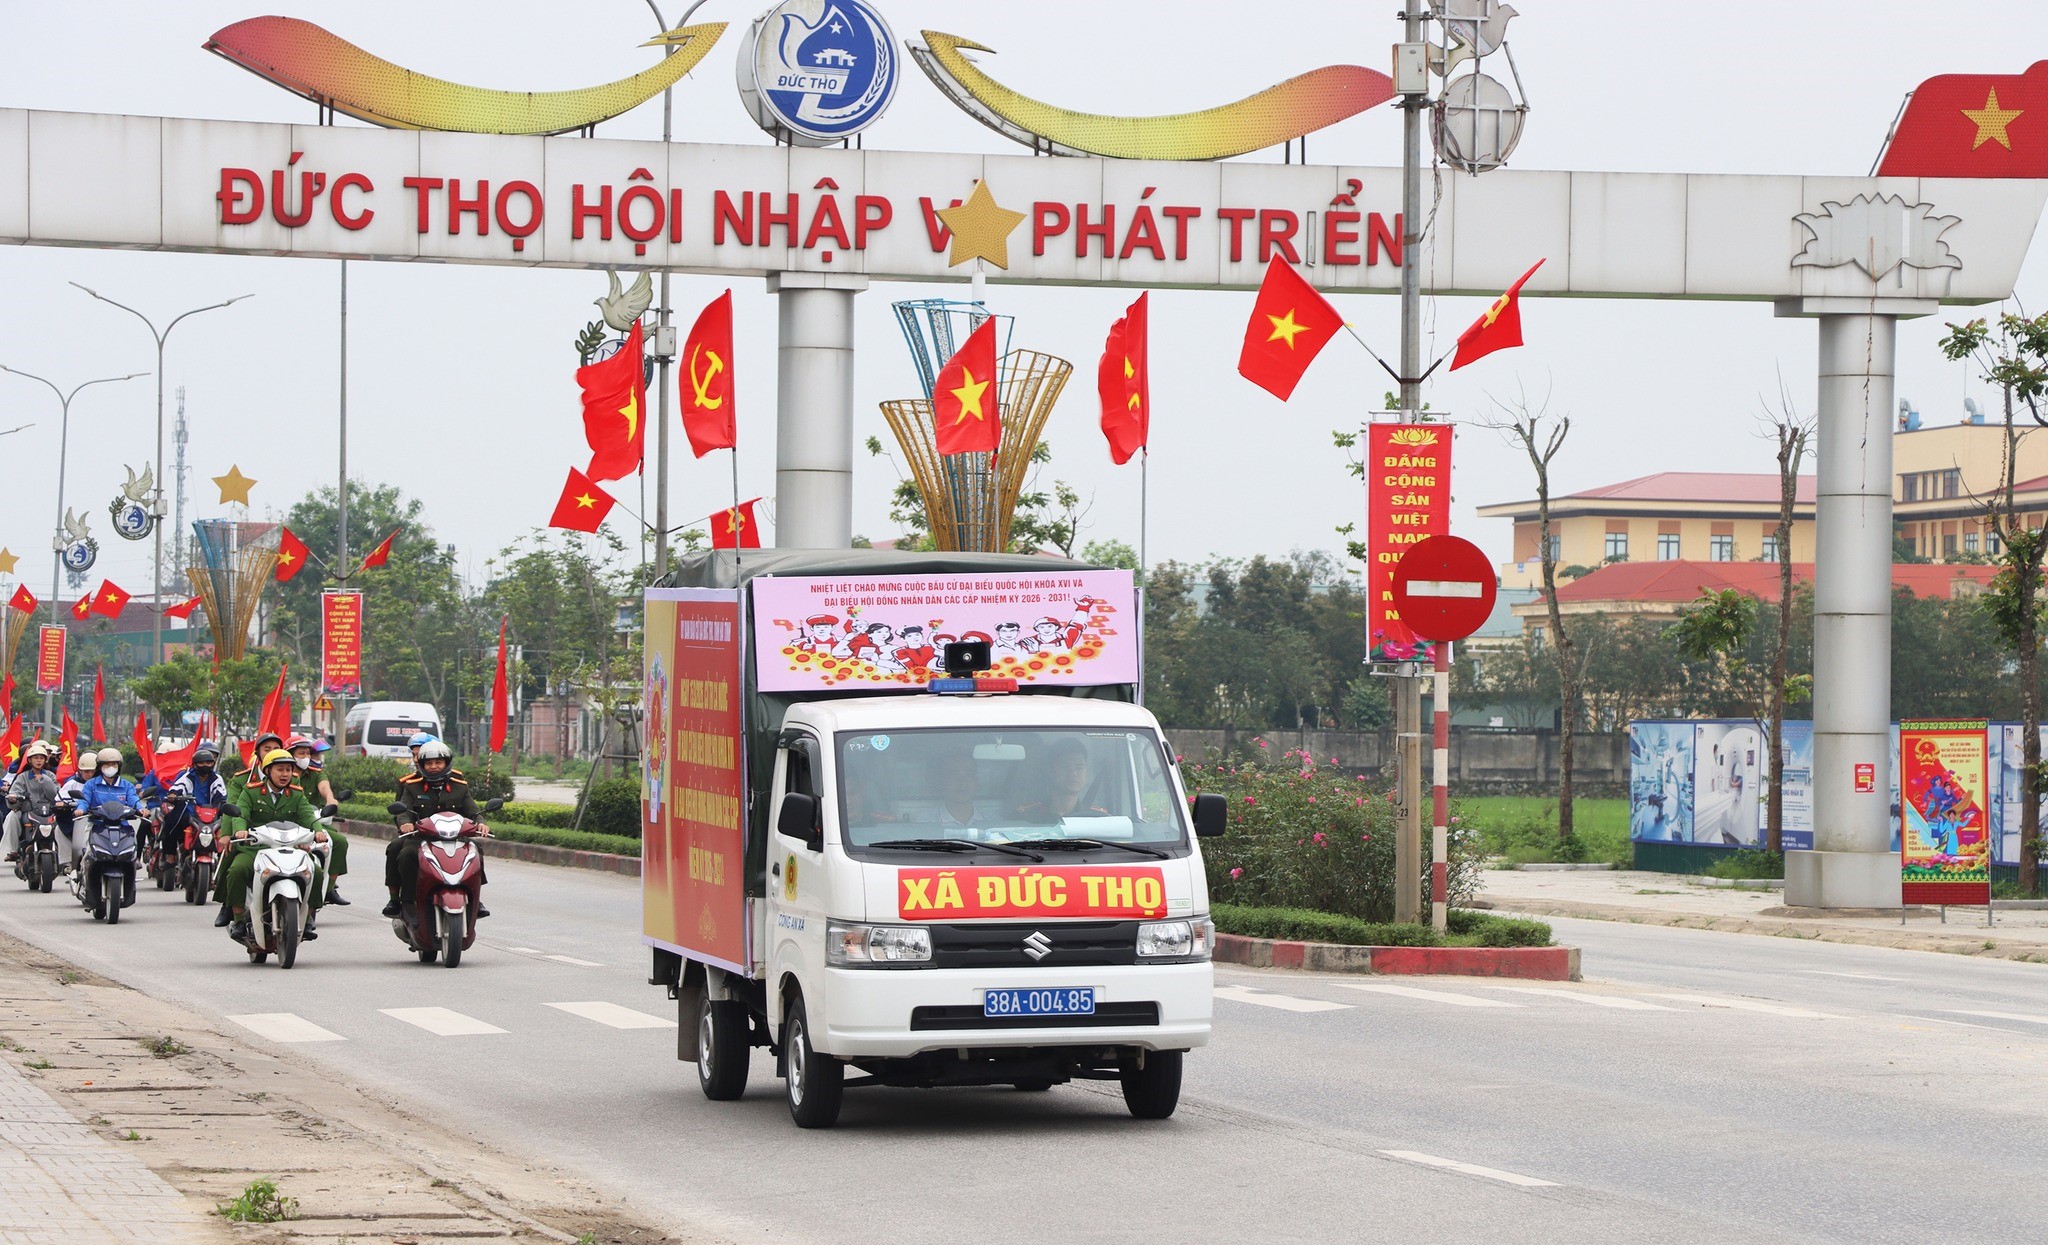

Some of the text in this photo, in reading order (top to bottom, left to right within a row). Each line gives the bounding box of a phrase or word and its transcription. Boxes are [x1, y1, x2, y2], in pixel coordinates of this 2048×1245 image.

[778, 74, 837, 92] ĐỨC THỌ
[216, 151, 375, 230] ĐỨC
[403, 176, 544, 252] THỌ
[572, 168, 683, 256] HỘI
[714, 177, 893, 263] NHẬP
[1032, 186, 1201, 261] PHÁT
[1384, 454, 1436, 468] ĐẢNG
[1384, 474, 1436, 488] CỘNG
[1391, 492, 1430, 506] SẢN
[1391, 511, 1430, 526] VIỆT
[810, 578, 1083, 594] NHIỆT LIỆT CHÀO MỪNG CUỘC BẦU CỬ ĐẠI BIỂU QUỐC HỘI KHÓA XVI VÀ
[824, 598, 838, 608] ĐẠI
[840, 594, 858, 606] BIỂU
[861, 596, 874, 607] HỘI
[877, 594, 898, 606] ĐỒNG
[901, 595, 923, 605] NHÂN
[926, 594, 942, 605] DÂN
[944, 594, 960, 604] CÁC
[963, 593, 978, 604] CẤP
[981, 594, 1007, 606] NHIỆM
[1021, 594, 1040, 603] 2026
[1048, 593, 1070, 602] 2031!
[902, 868, 1162, 916] XÃ ĐỨC THỌ
[988, 990, 1091, 1013] 38A-004.85
